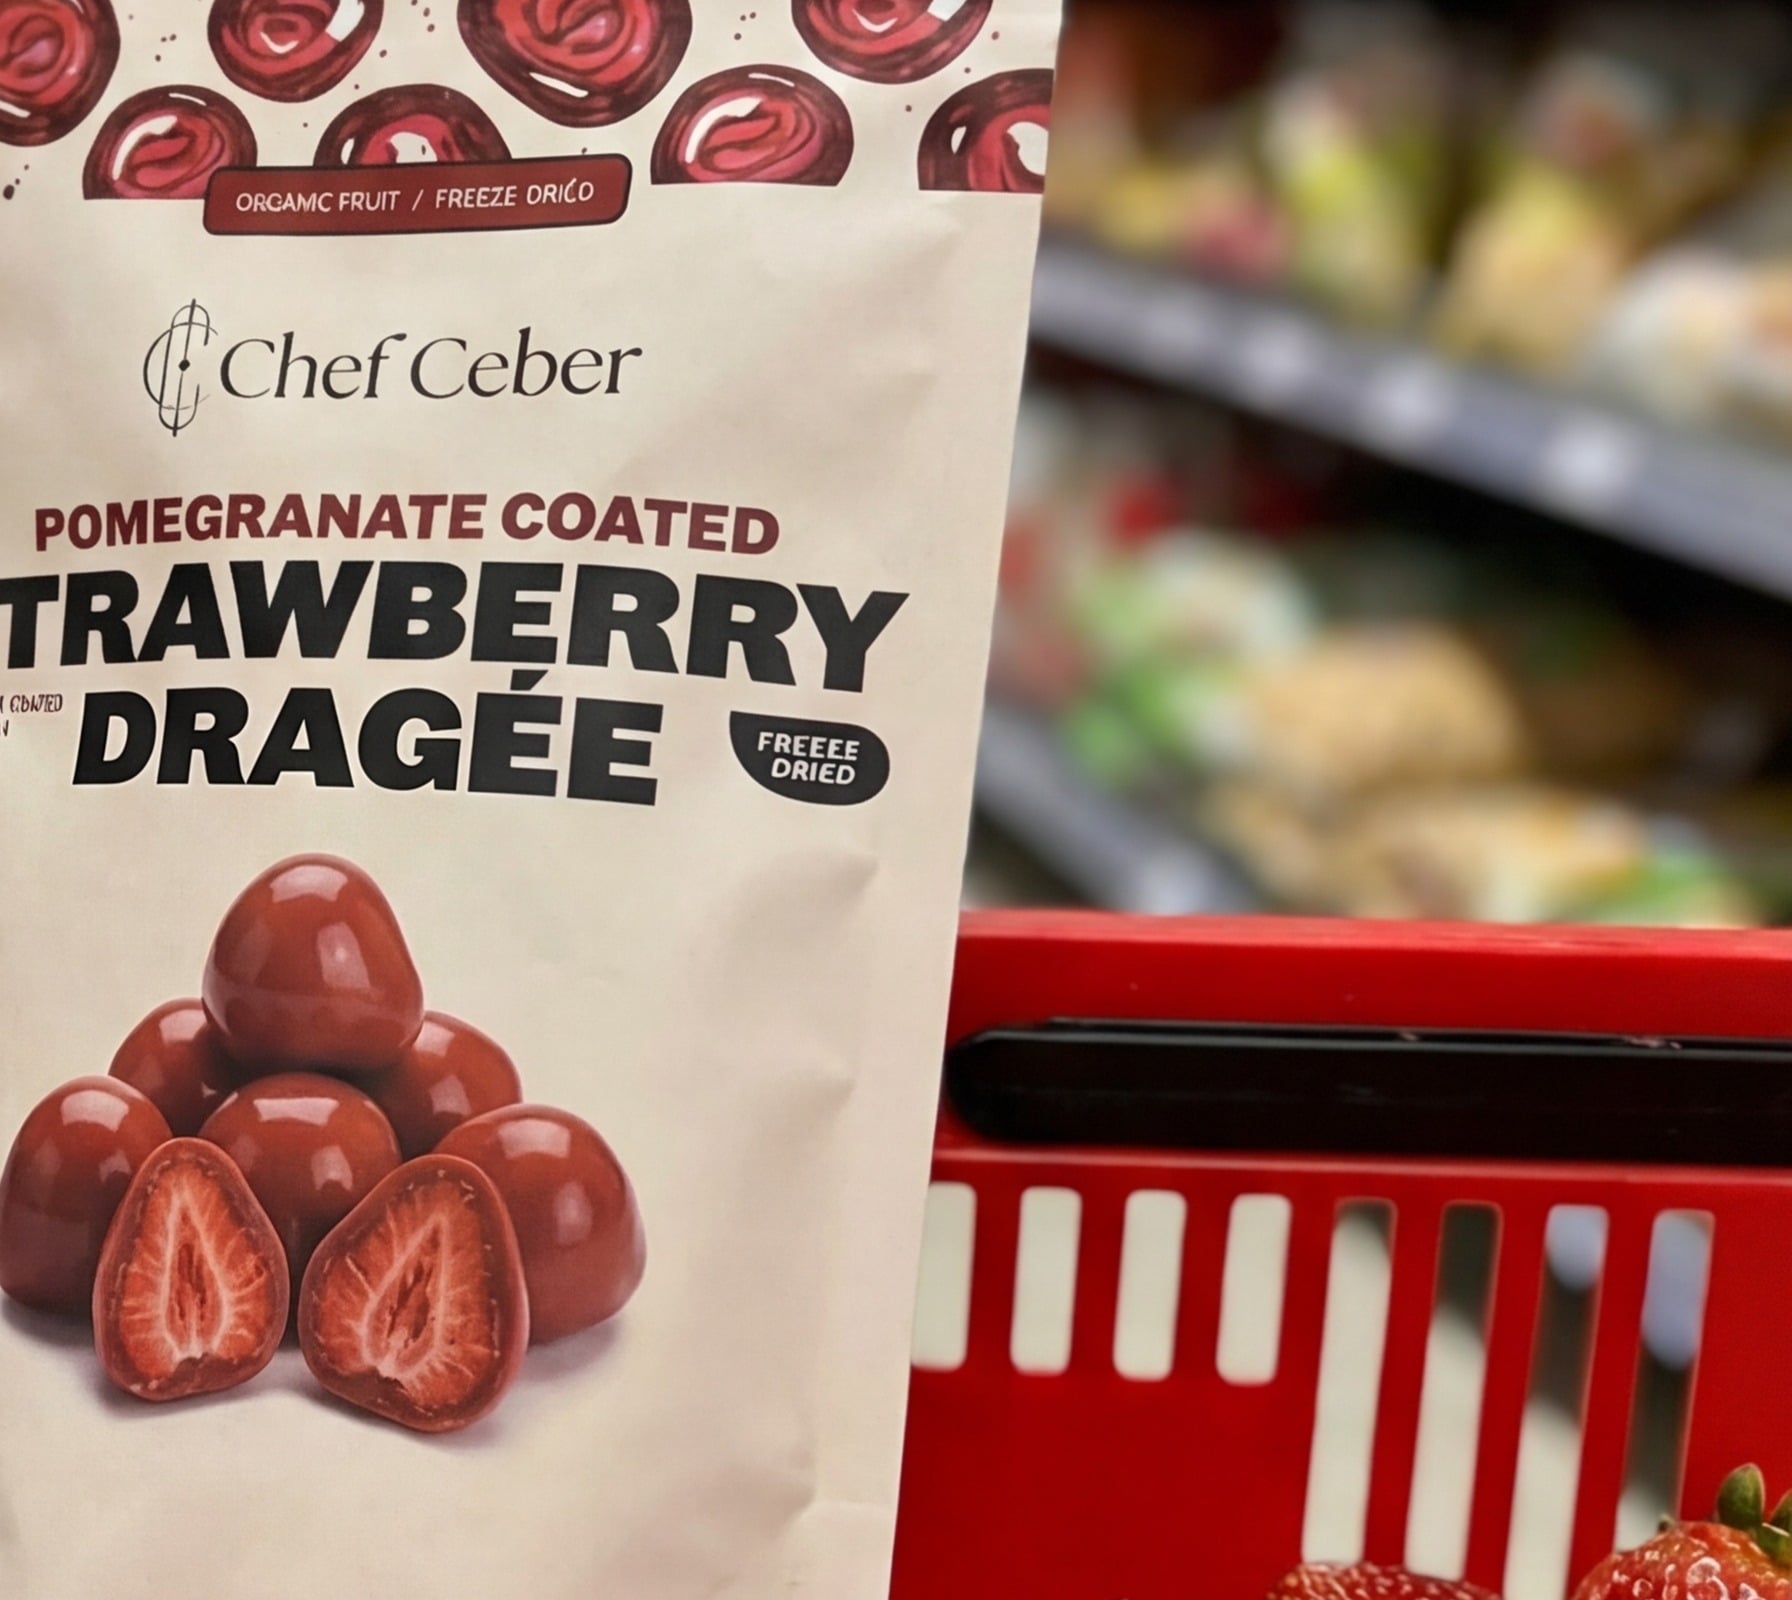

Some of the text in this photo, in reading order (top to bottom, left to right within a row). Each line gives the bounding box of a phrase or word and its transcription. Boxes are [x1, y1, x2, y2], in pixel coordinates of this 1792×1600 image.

[338, 190, 401, 212] FRUIT
[435, 185, 518, 209] FREEZE
[219, 326, 643, 400] Chef Ceber
[32, 491, 781, 556] POMEGRANATE COATED
[71, 668, 664, 807] DRAGÉE
[757, 731, 860, 762] FREEEE
[770, 757, 856, 786] DRIED
